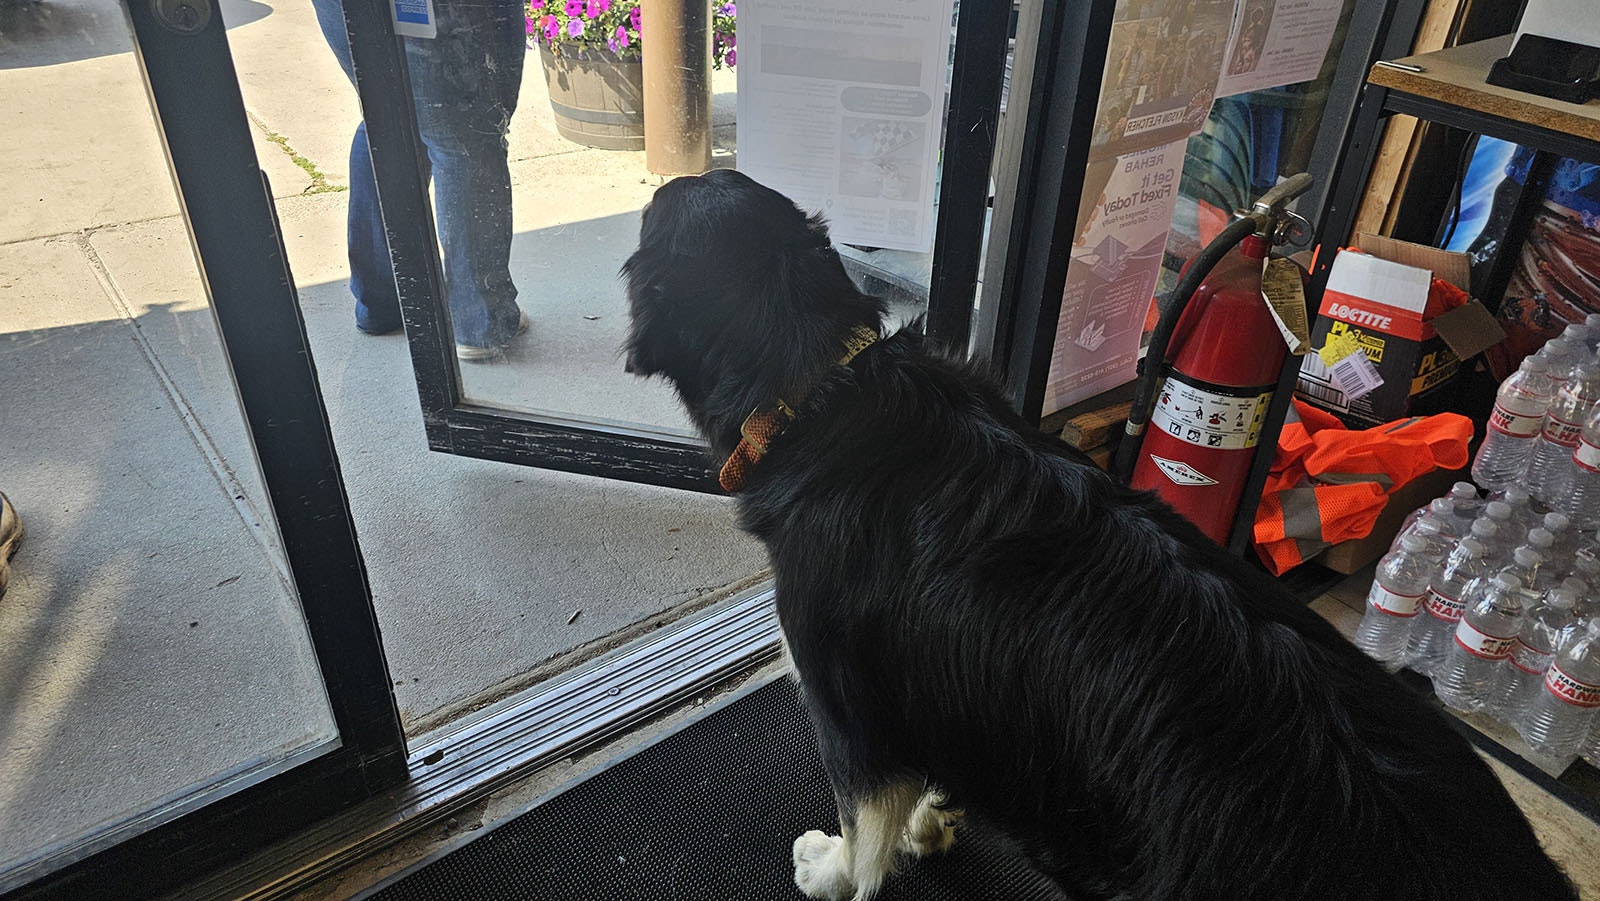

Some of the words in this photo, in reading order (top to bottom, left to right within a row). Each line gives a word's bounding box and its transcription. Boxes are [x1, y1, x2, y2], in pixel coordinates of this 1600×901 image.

[1328, 303, 1392, 330] LOCTITE
[1418, 353, 1438, 376] PL
[1159, 462, 1205, 482] AMEREX
[1431, 600, 1464, 617] HAN
